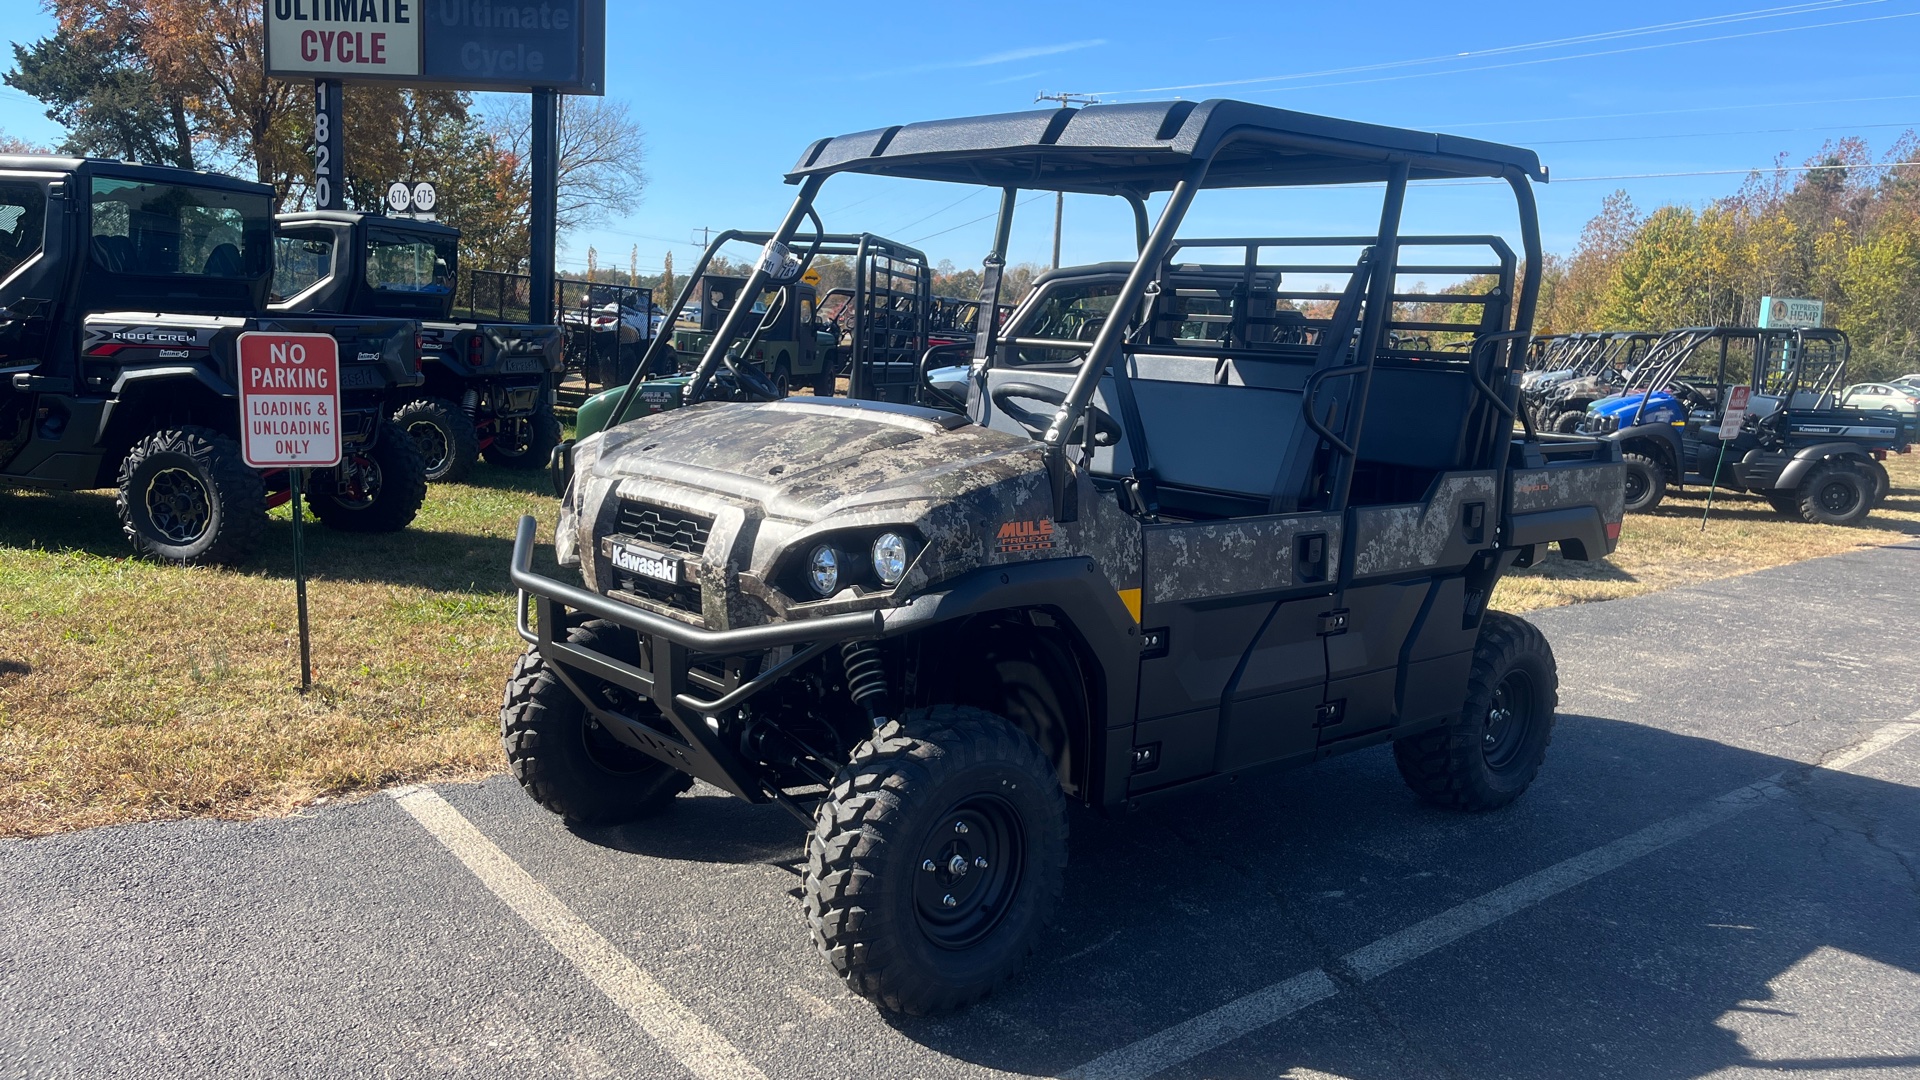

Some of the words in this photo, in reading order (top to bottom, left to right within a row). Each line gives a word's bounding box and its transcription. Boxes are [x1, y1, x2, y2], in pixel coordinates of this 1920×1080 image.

[275, 0, 410, 23] ULTIMATE
[440, 0, 570, 30] Ultimate
[300, 29, 387, 64] CYCLE
[461, 41, 545, 73] Cycle
[315, 82, 331, 208] 1820
[391, 190, 408, 203] 676
[416, 190, 434, 203] 675
[1790, 303, 1820, 312] CYPRESS
[1789, 310, 1819, 322] HEMP
[112, 332, 155, 342] RIDGE
[158, 333, 196, 343] CREW
[270, 343, 306, 365] NO
[506, 359, 538, 371] Kawasaki
[251, 367, 328, 389] PARKING
[253, 401, 312, 416] LOADING
[317, 402, 328, 416] &
[253, 420, 331, 436] UNLOADING
[275, 439, 310, 455] ONLY
[997, 519, 1054, 538] MULE
[1002, 542, 1051, 552] 1000
[612, 544, 677, 583] Kawasaki
